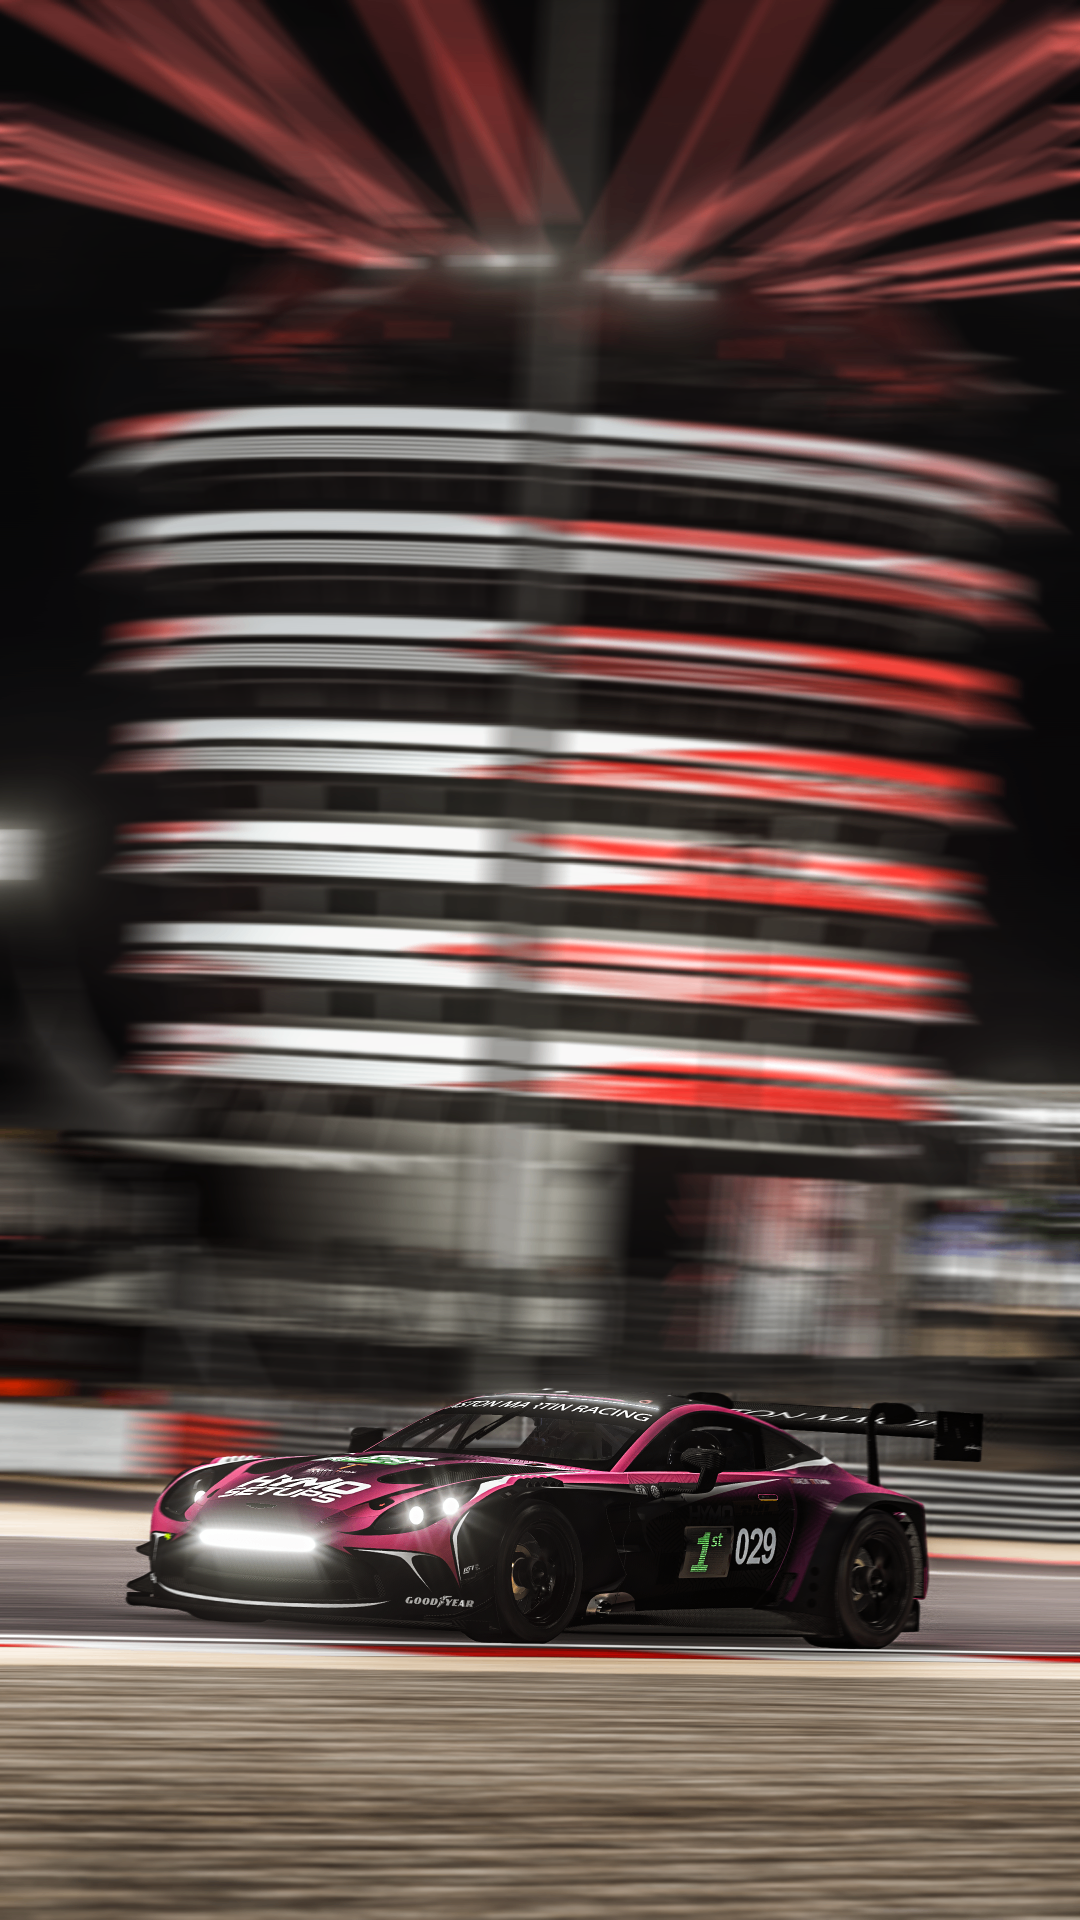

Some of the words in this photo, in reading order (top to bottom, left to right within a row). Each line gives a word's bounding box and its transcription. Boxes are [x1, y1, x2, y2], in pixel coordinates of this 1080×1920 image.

[571, 1405, 653, 1422] RACING
[238, 1474, 372, 1495] HYMO
[218, 1486, 342, 1504] SETUPS
[690, 1532, 724, 1572] 1st
[735, 1527, 777, 1565] 029
[405, 1595, 475, 1609] GOODYEAR
